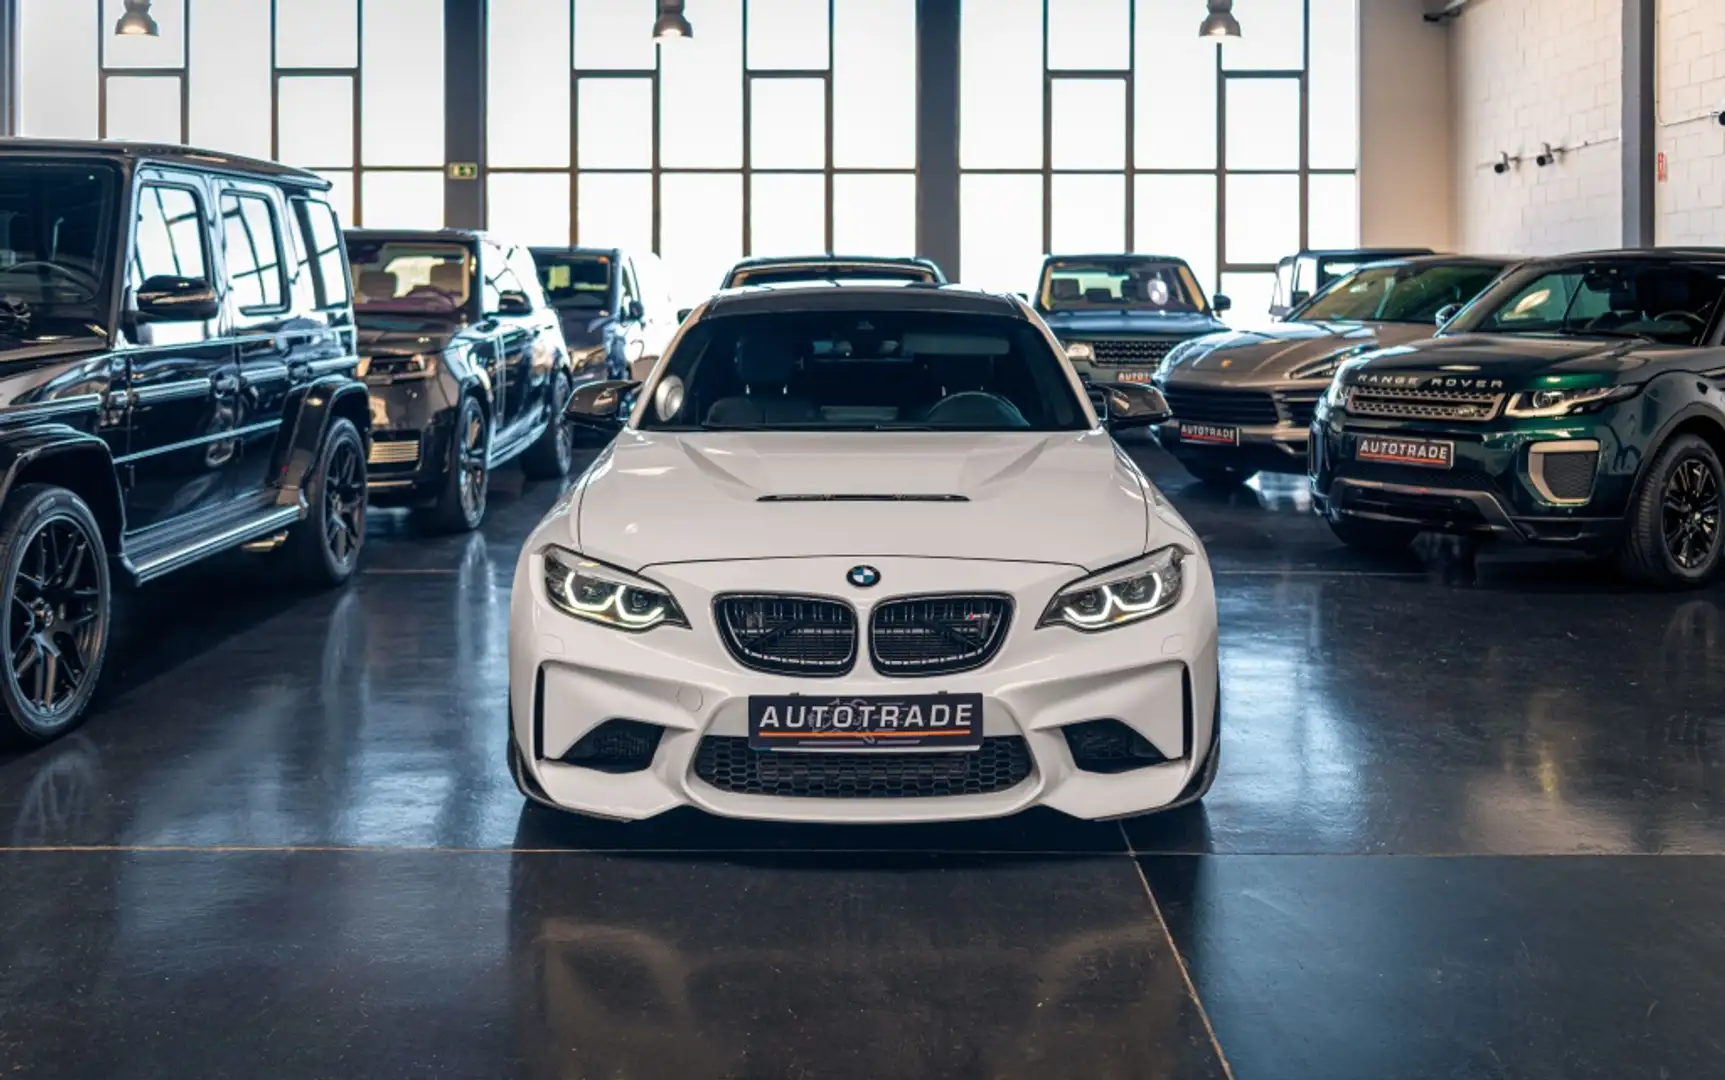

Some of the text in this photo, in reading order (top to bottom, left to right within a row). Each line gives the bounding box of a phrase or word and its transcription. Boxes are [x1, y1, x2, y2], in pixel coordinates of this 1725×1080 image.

[1118, 371, 1149, 381] AUTOT
[1358, 374, 1503, 389] RANGE ROVER
[1181, 423, 1234, 439] AUTOTRADE
[1360, 439, 1448, 459] AUTOTRADE
[759, 704, 973, 728] AUTOTRADE
